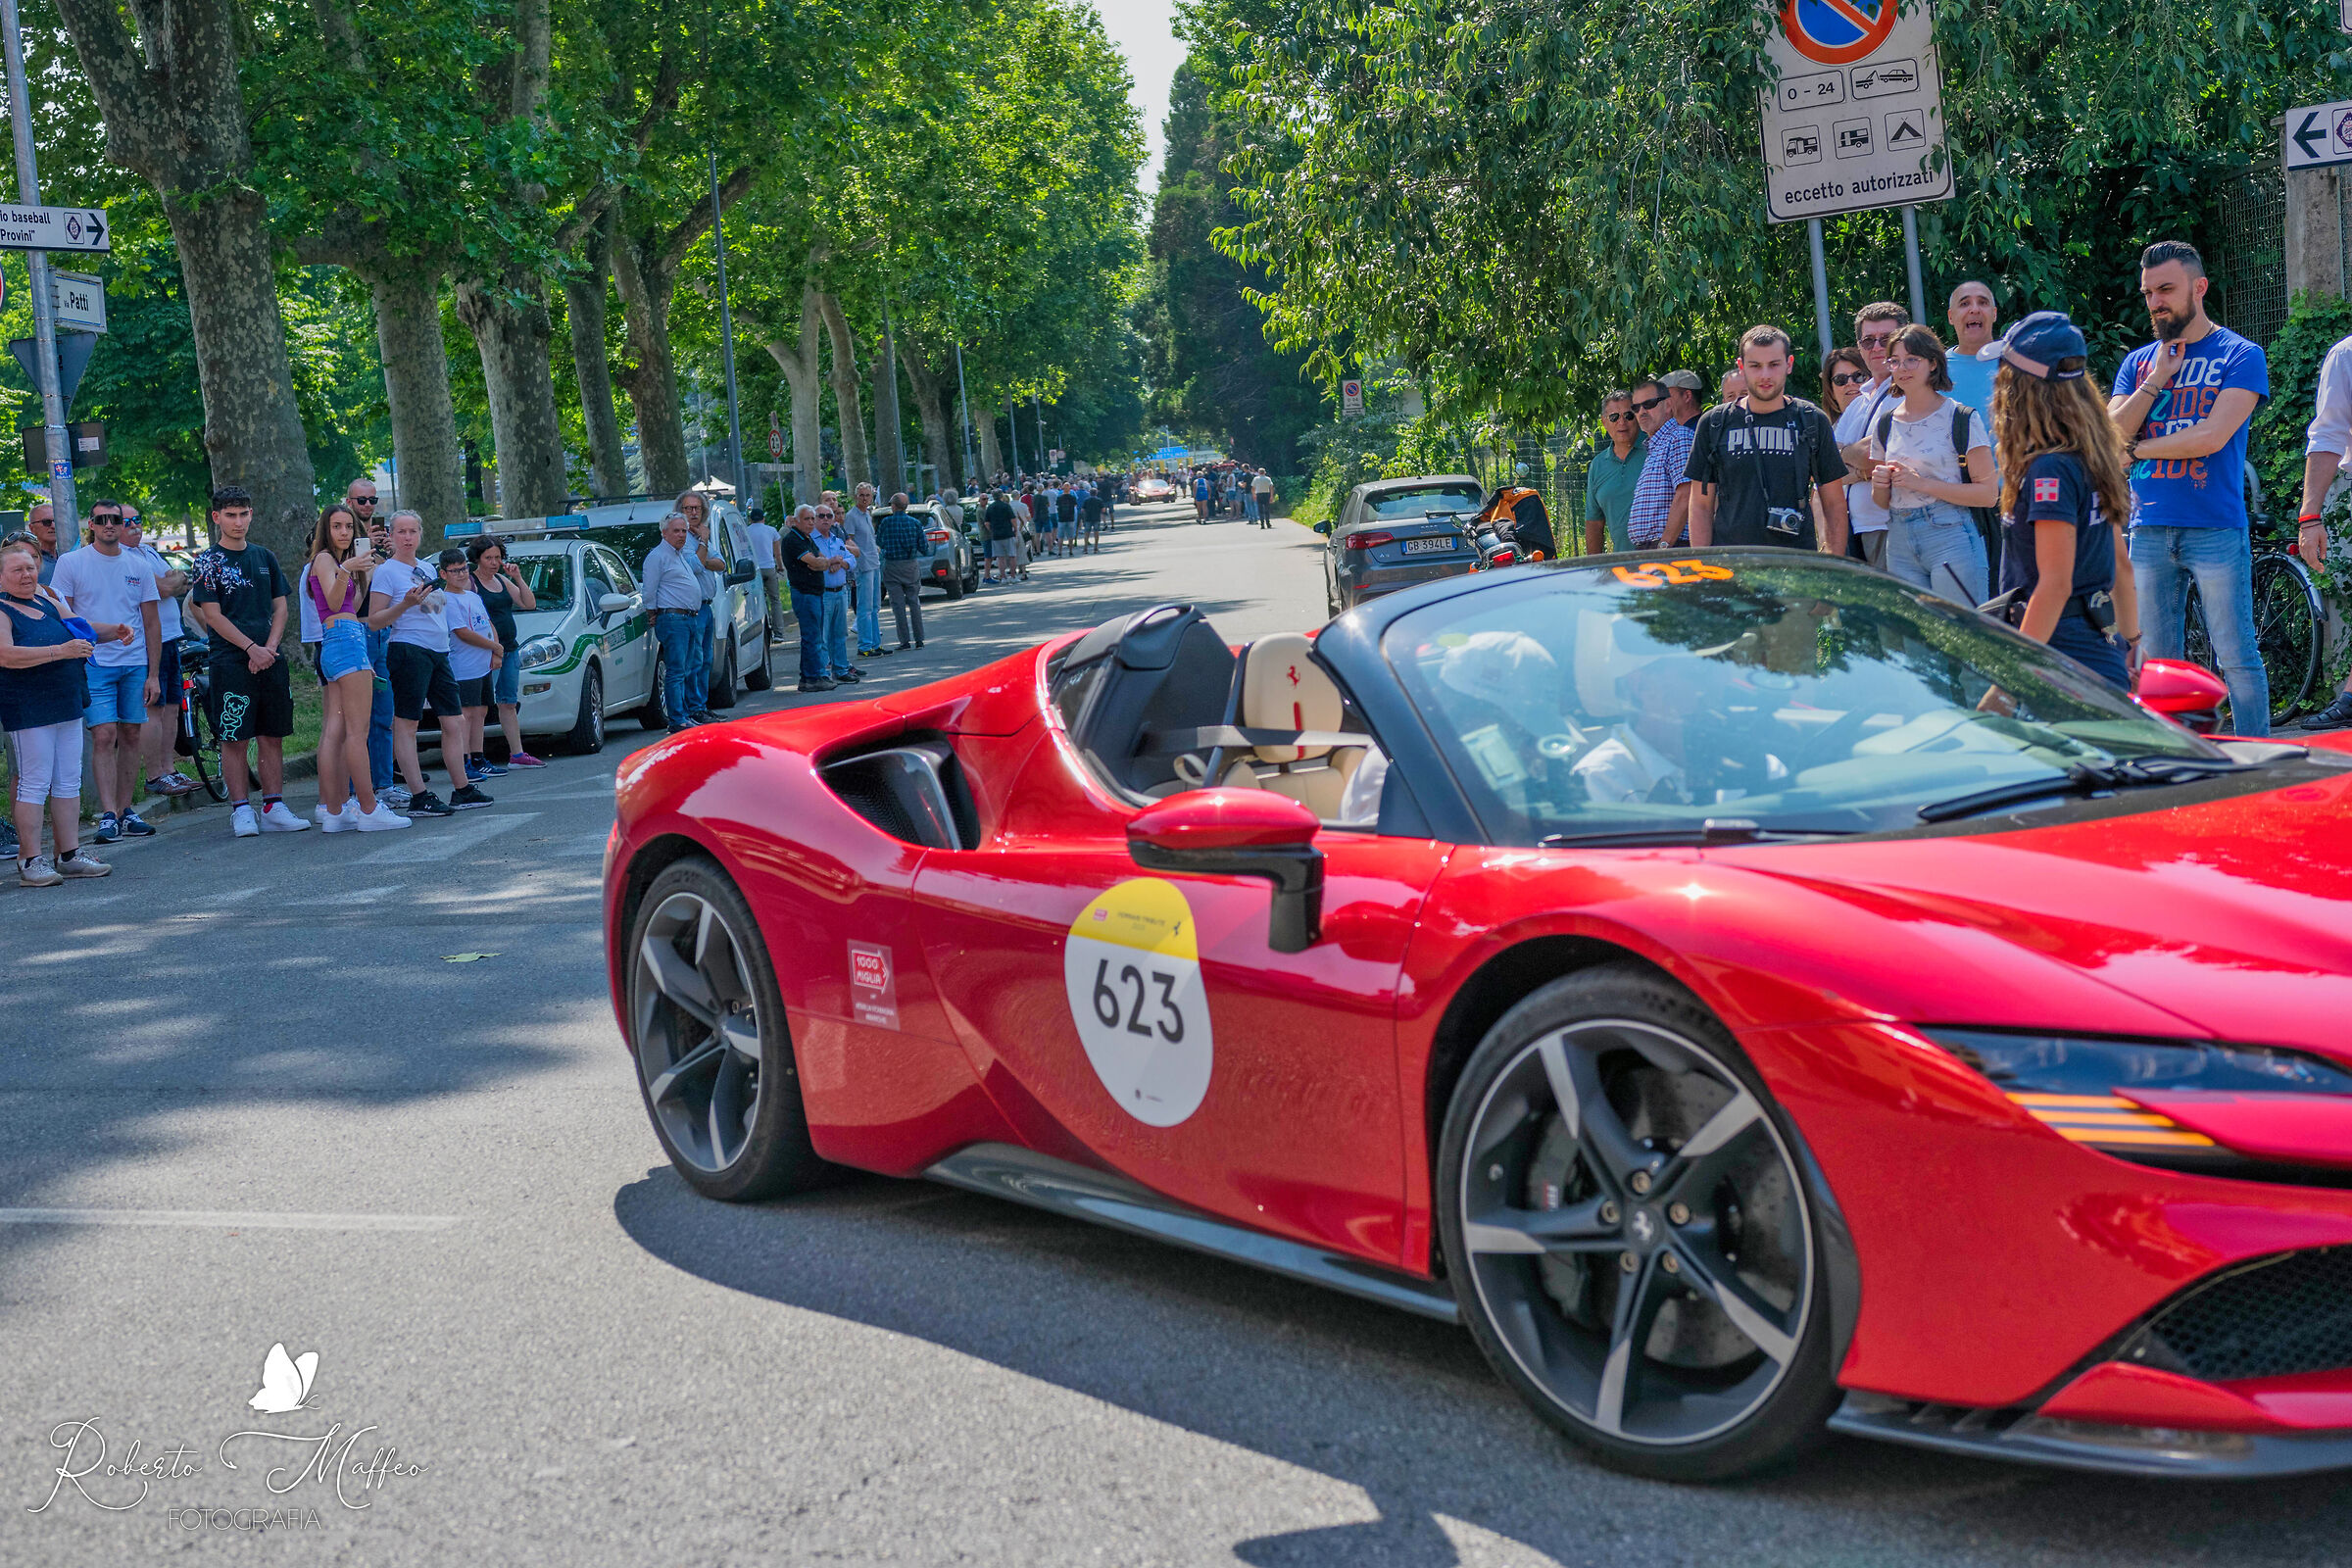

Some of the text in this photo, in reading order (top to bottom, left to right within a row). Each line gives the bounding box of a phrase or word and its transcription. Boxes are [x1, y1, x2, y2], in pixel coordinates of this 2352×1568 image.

[1818, 82, 1836, 95] 24
[1785, 167, 1934, 204] eccetto autorizzati
[12, 211, 51, 224] baseball
[70, 291, 89, 312] Patti
[1728, 426, 1799, 452] PUMA
[1407, 538, 1451, 552] GB 394LE
[1612, 560, 1734, 587] 623
[856, 956, 879, 969] 1000
[856, 970, 882, 985] MIGLIA
[1093, 958, 1184, 1044] 623
